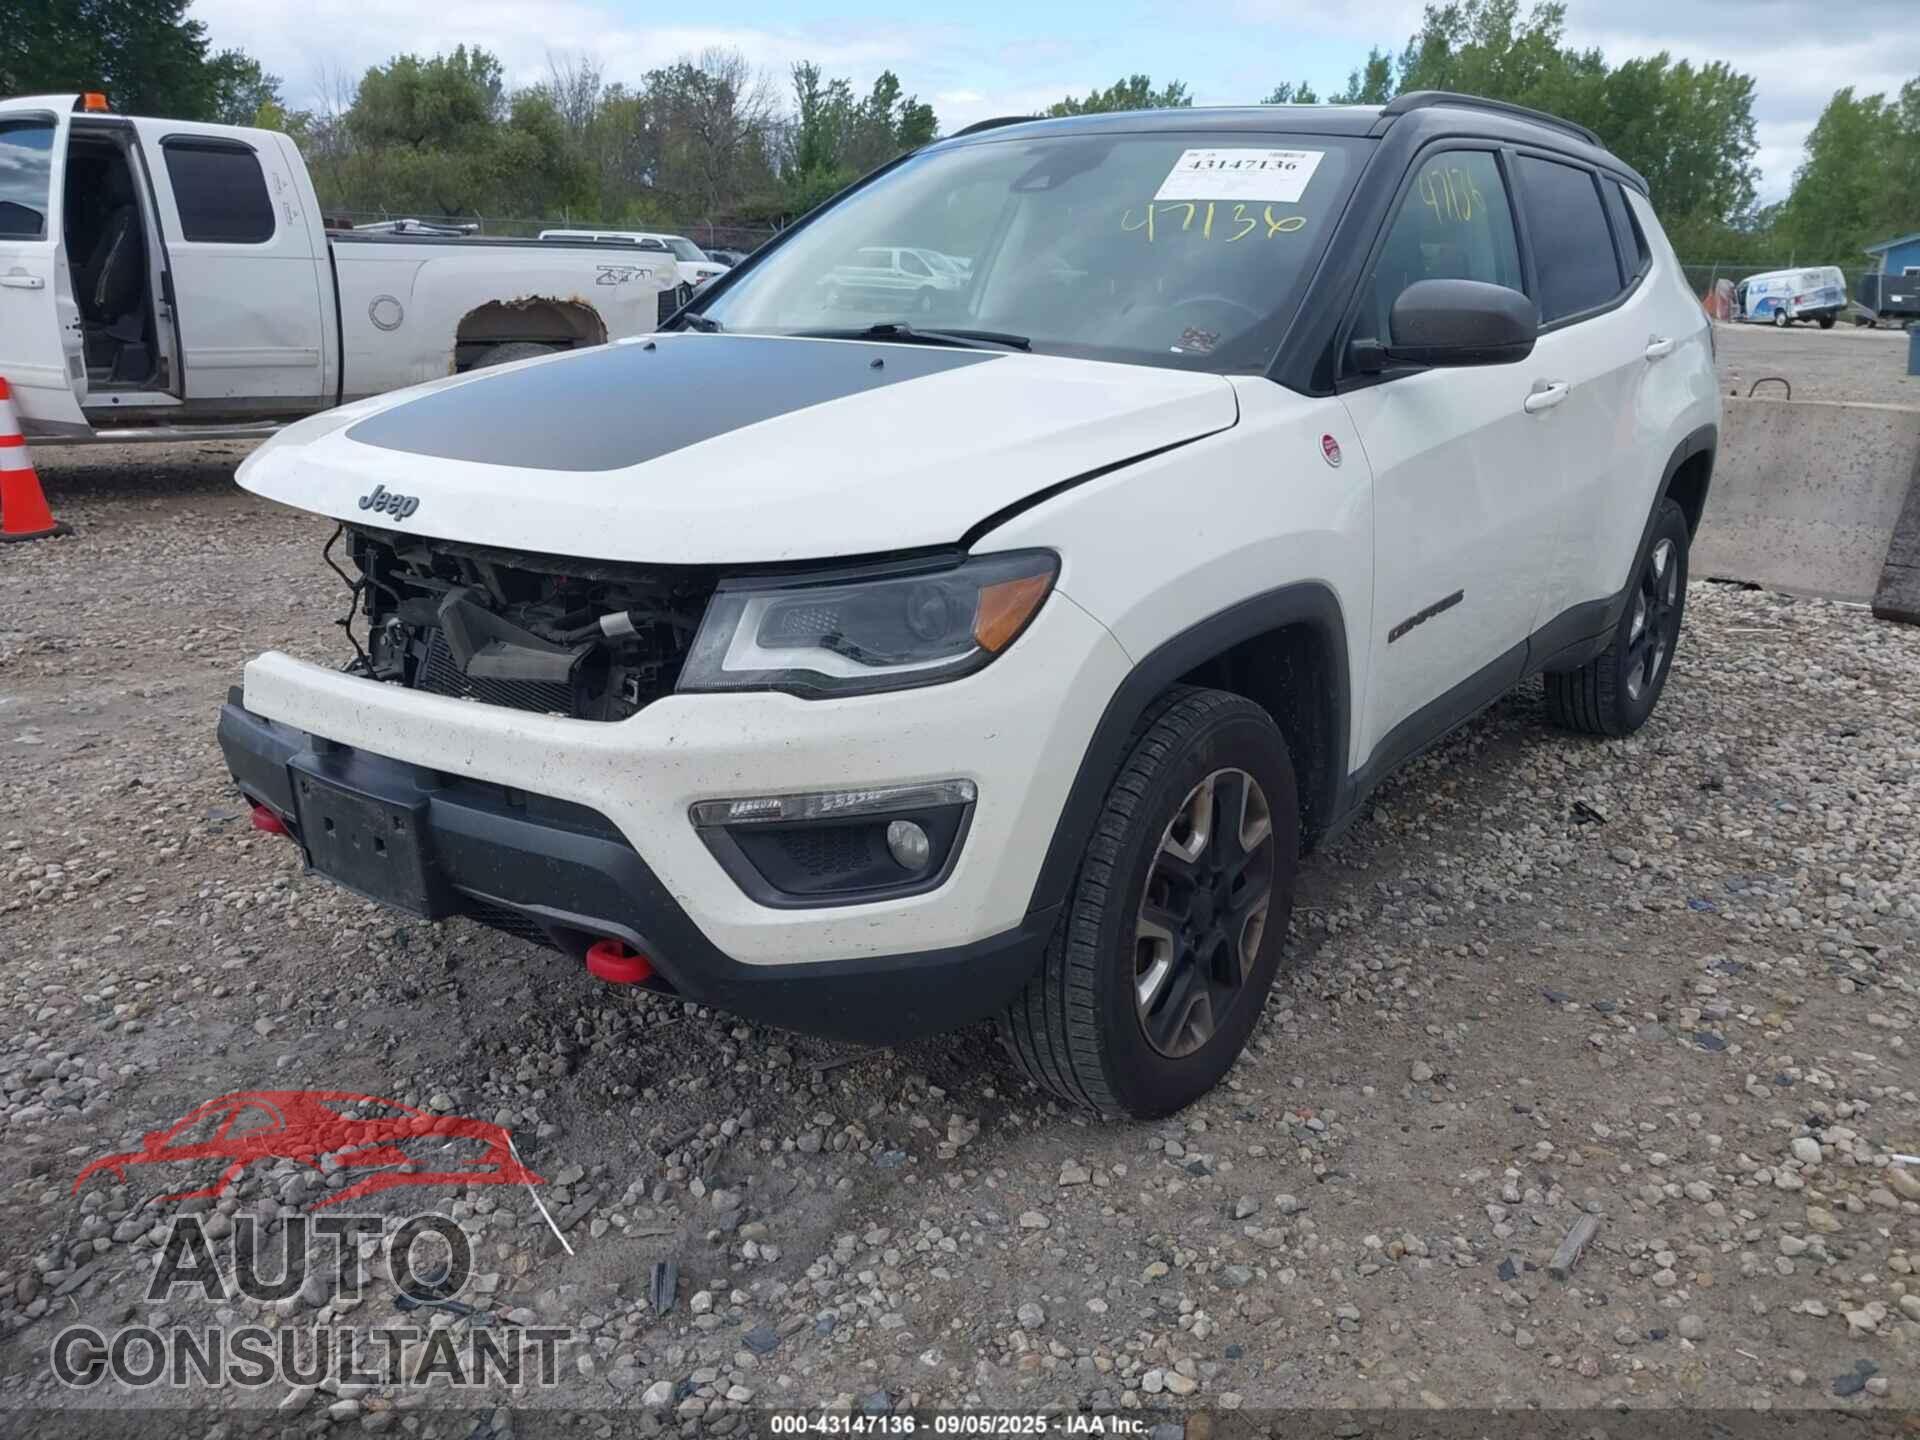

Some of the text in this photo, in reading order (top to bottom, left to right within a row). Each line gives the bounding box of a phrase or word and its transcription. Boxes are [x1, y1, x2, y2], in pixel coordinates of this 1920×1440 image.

[1187, 159, 1298, 170] 43147136
[1120, 202, 1307, 242] 47136
[358, 484, 420, 522] Jeep
